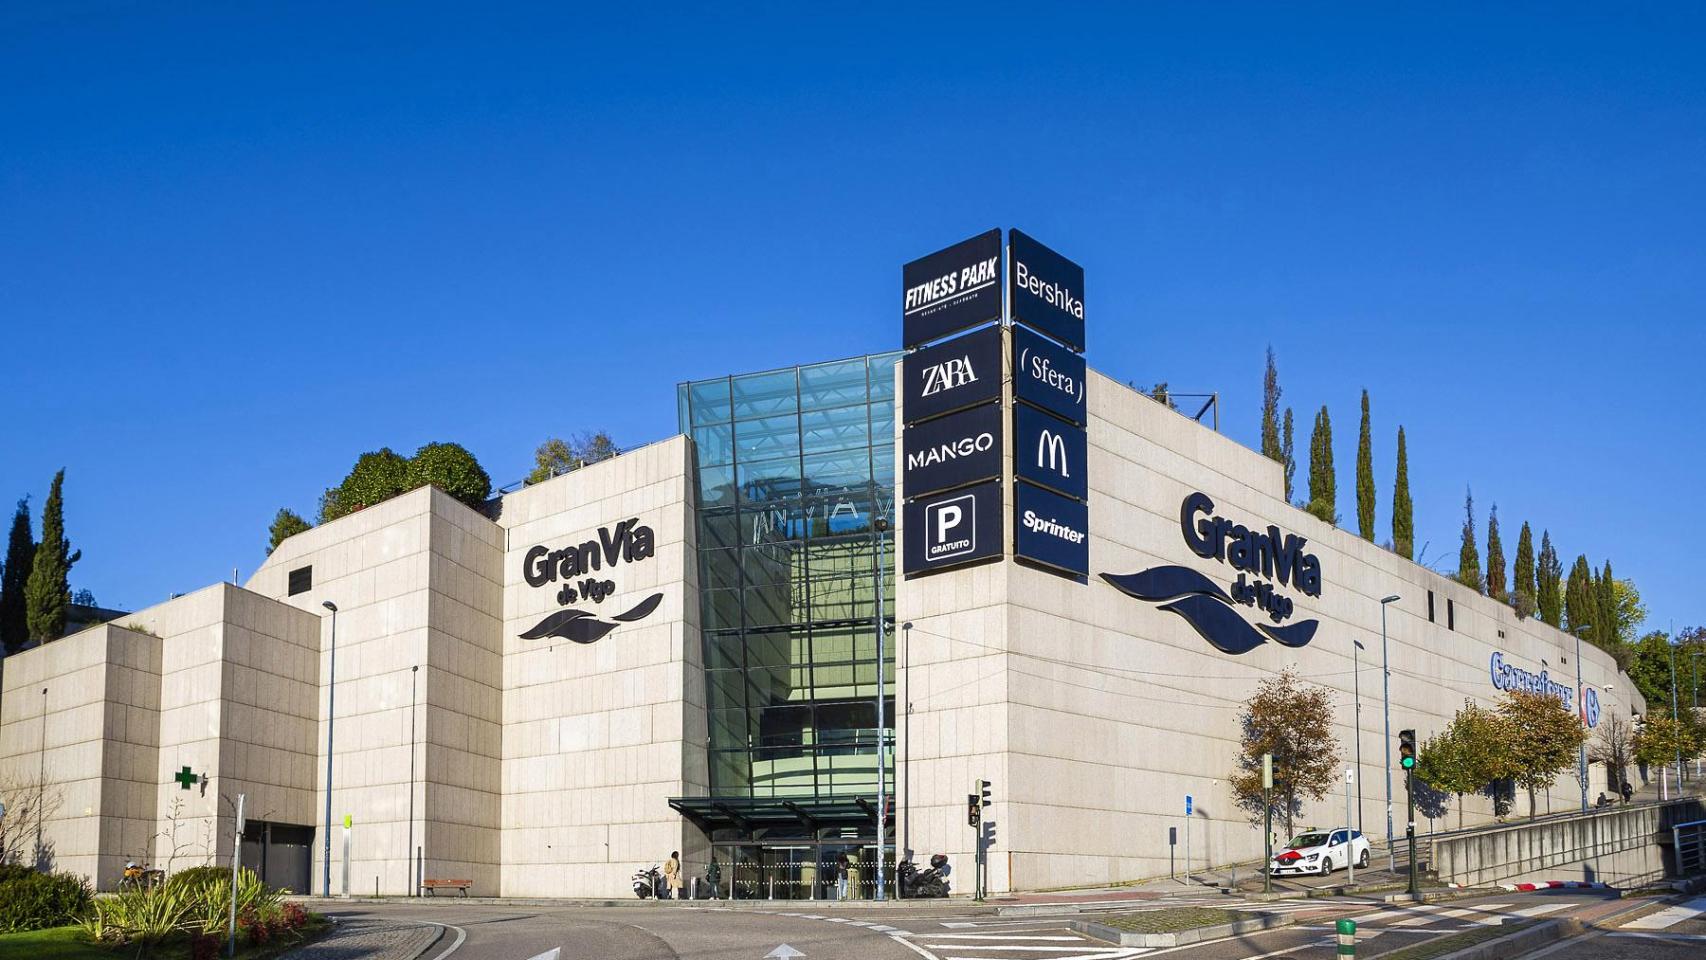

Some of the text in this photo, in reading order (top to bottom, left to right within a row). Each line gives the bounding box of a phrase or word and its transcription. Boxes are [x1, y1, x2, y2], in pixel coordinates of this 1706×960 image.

[905, 271, 957, 310] FITNESS
[960, 256, 998, 290] PARK
[1016, 261, 1083, 320] Bershka
[921, 354, 979, 397] ZARA
[908, 432, 994, 471] MANGO
[938, 505, 962, 543] P
[1023, 510, 1085, 544] Sprinter
[931, 539, 970, 554] GRATUITO
[557, 578, 616, 606] de Vigo
[1230, 573, 1293, 624] de Vigo
